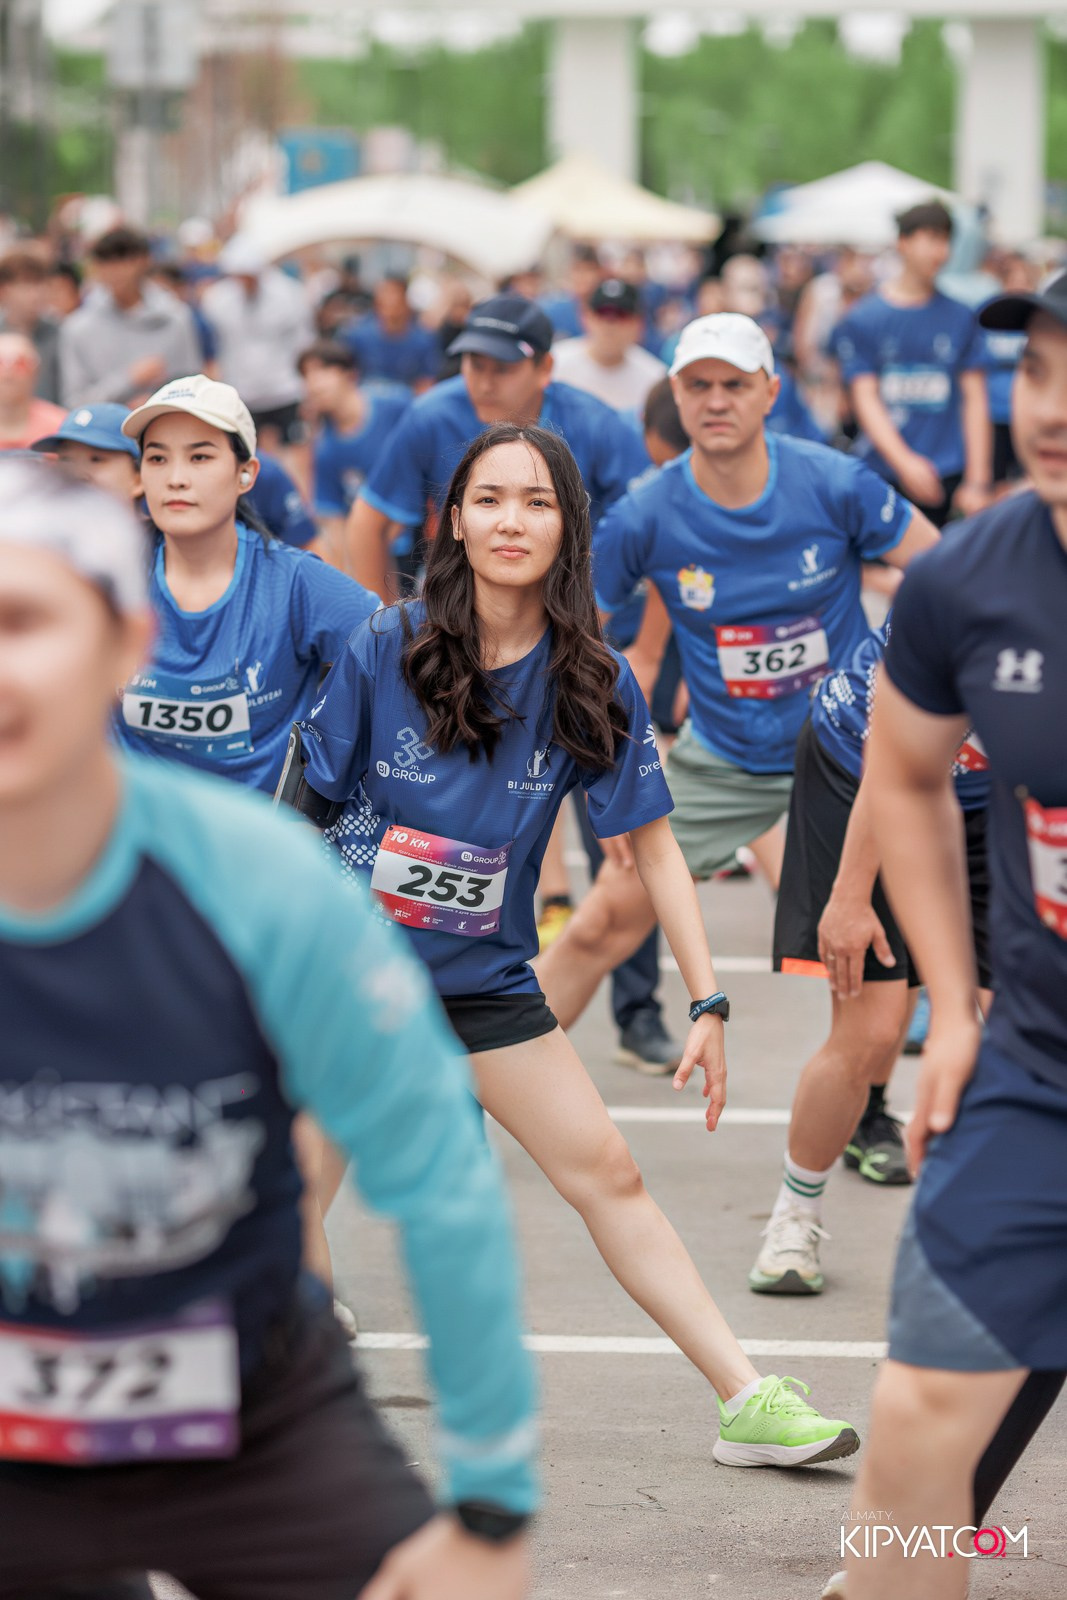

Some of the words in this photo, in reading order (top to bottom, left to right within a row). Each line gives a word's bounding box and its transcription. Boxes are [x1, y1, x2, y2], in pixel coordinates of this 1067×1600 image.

[743, 643, 806, 676] 362
[140, 678, 157, 688] KM
[139, 702, 233, 732] 1350
[391, 767, 436, 784] GROUP
[507, 780, 518, 790] BI
[390, 830, 409, 844] 10
[409, 837, 431, 850] KM
[473, 855, 499, 865] GROUP
[396, 864, 493, 908] 253
